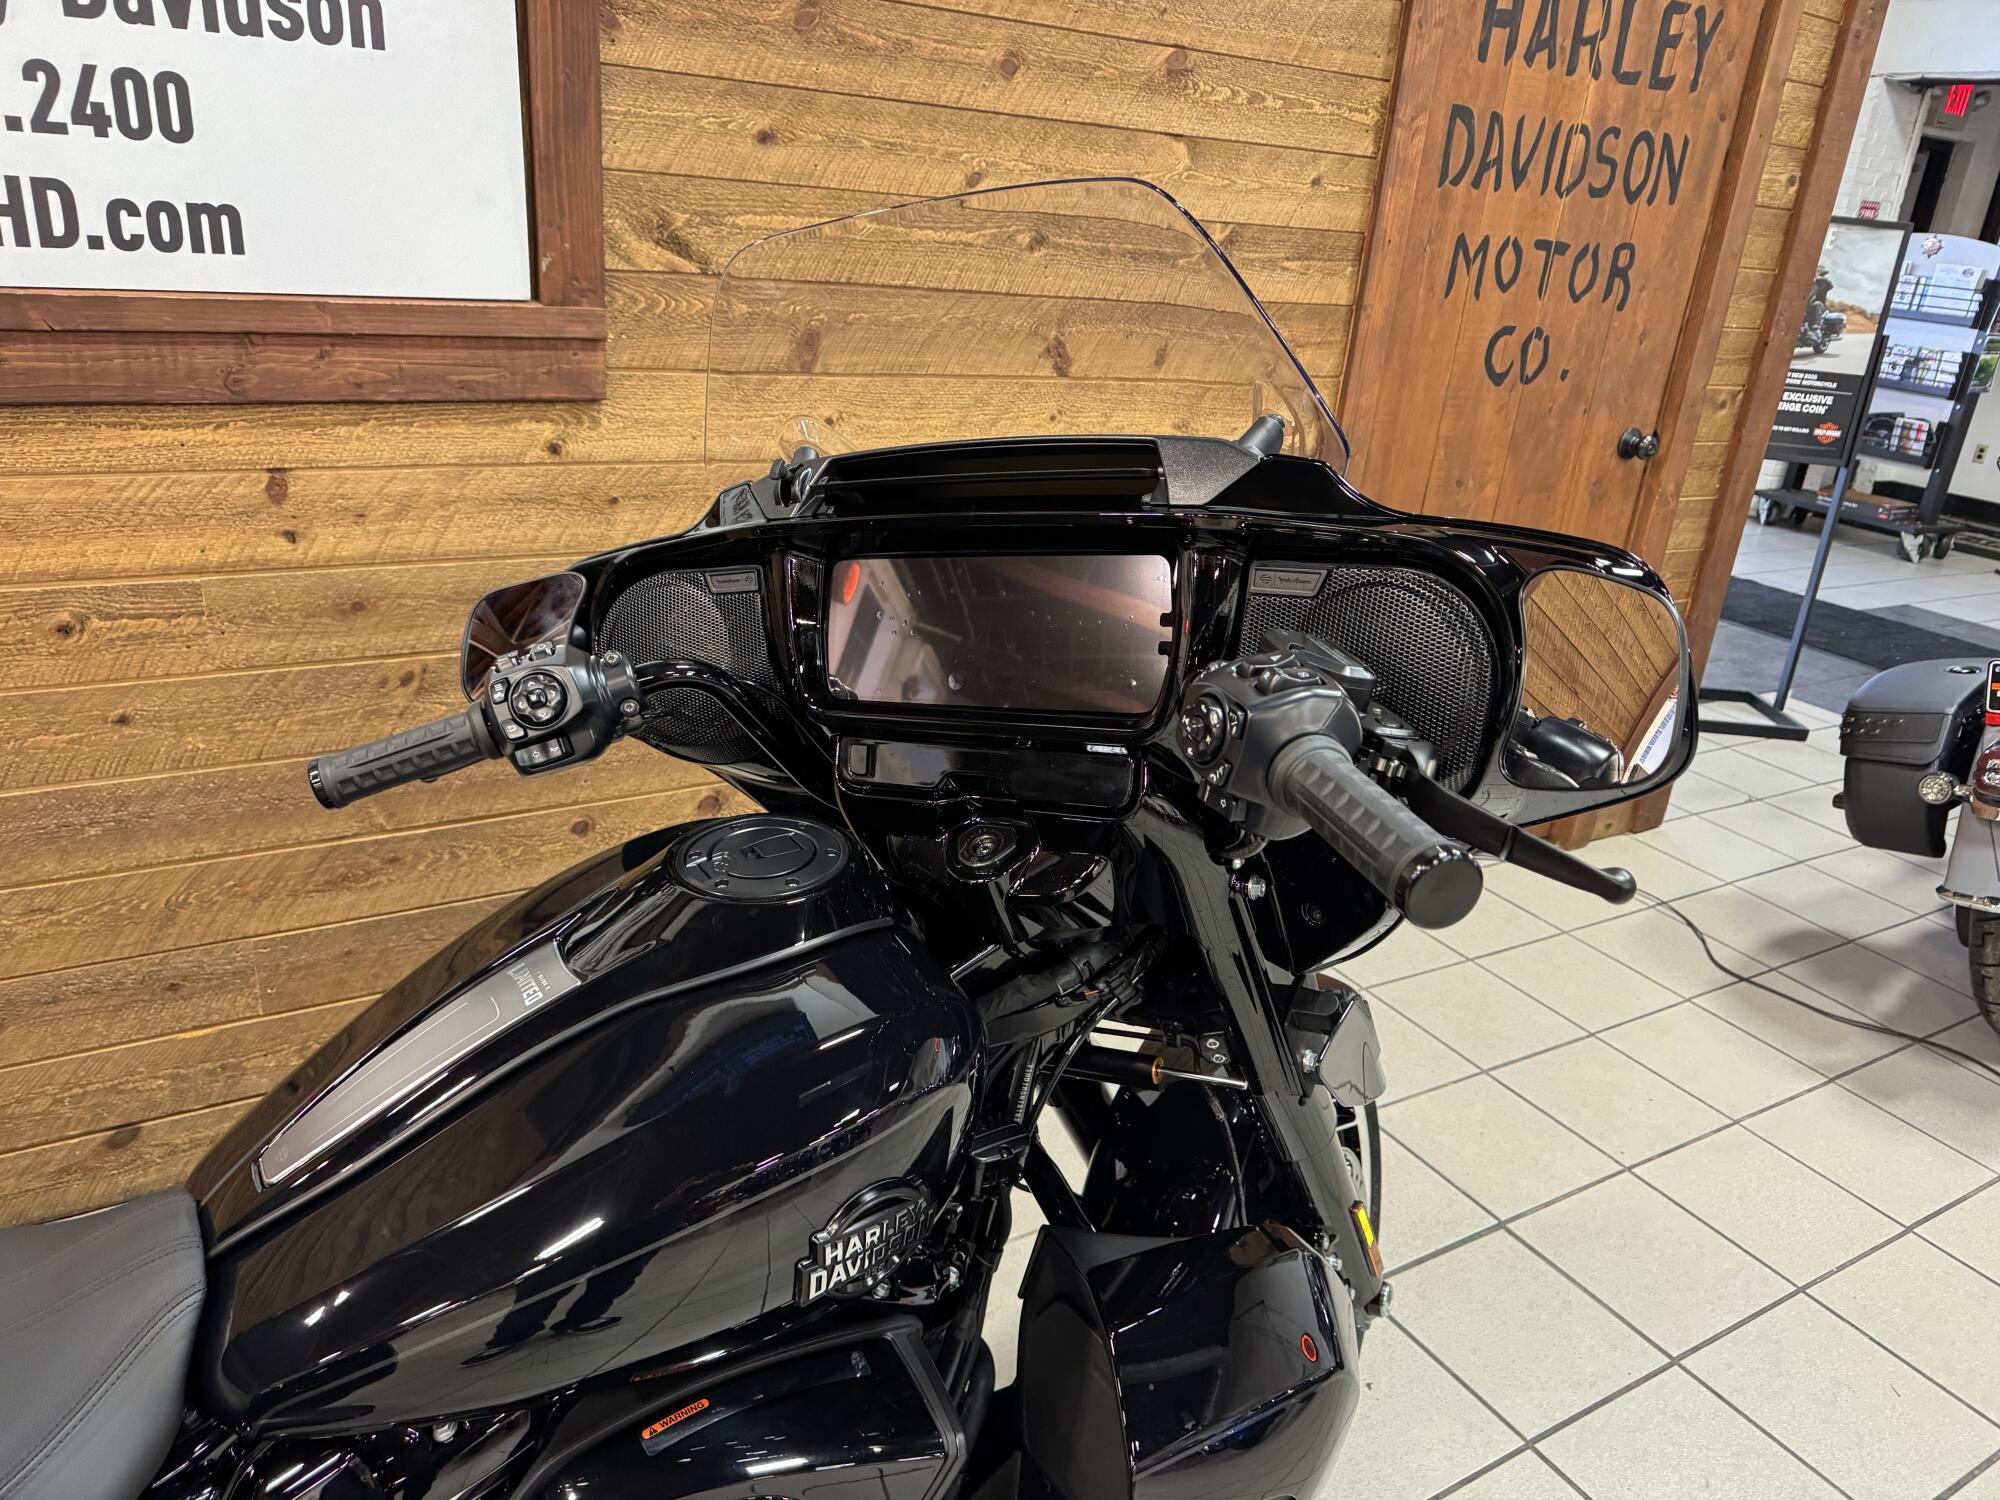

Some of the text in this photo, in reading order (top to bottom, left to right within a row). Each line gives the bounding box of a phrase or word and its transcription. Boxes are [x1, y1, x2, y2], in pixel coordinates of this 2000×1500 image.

[1478, 0, 1724, 92] HARLEY
[1944, 84, 1975, 117] EXIT
[1438, 104, 1689, 207] DAVIDSON
[1444, 233, 1636, 312] MOTOR
[1485, 326, 1570, 387] CO.
[1782, 391, 1834, 405] EXCLUSIVE
[1802, 379, 1838, 388] MOTORCYCLE
[660, 1401, 705, 1428] WARNING
